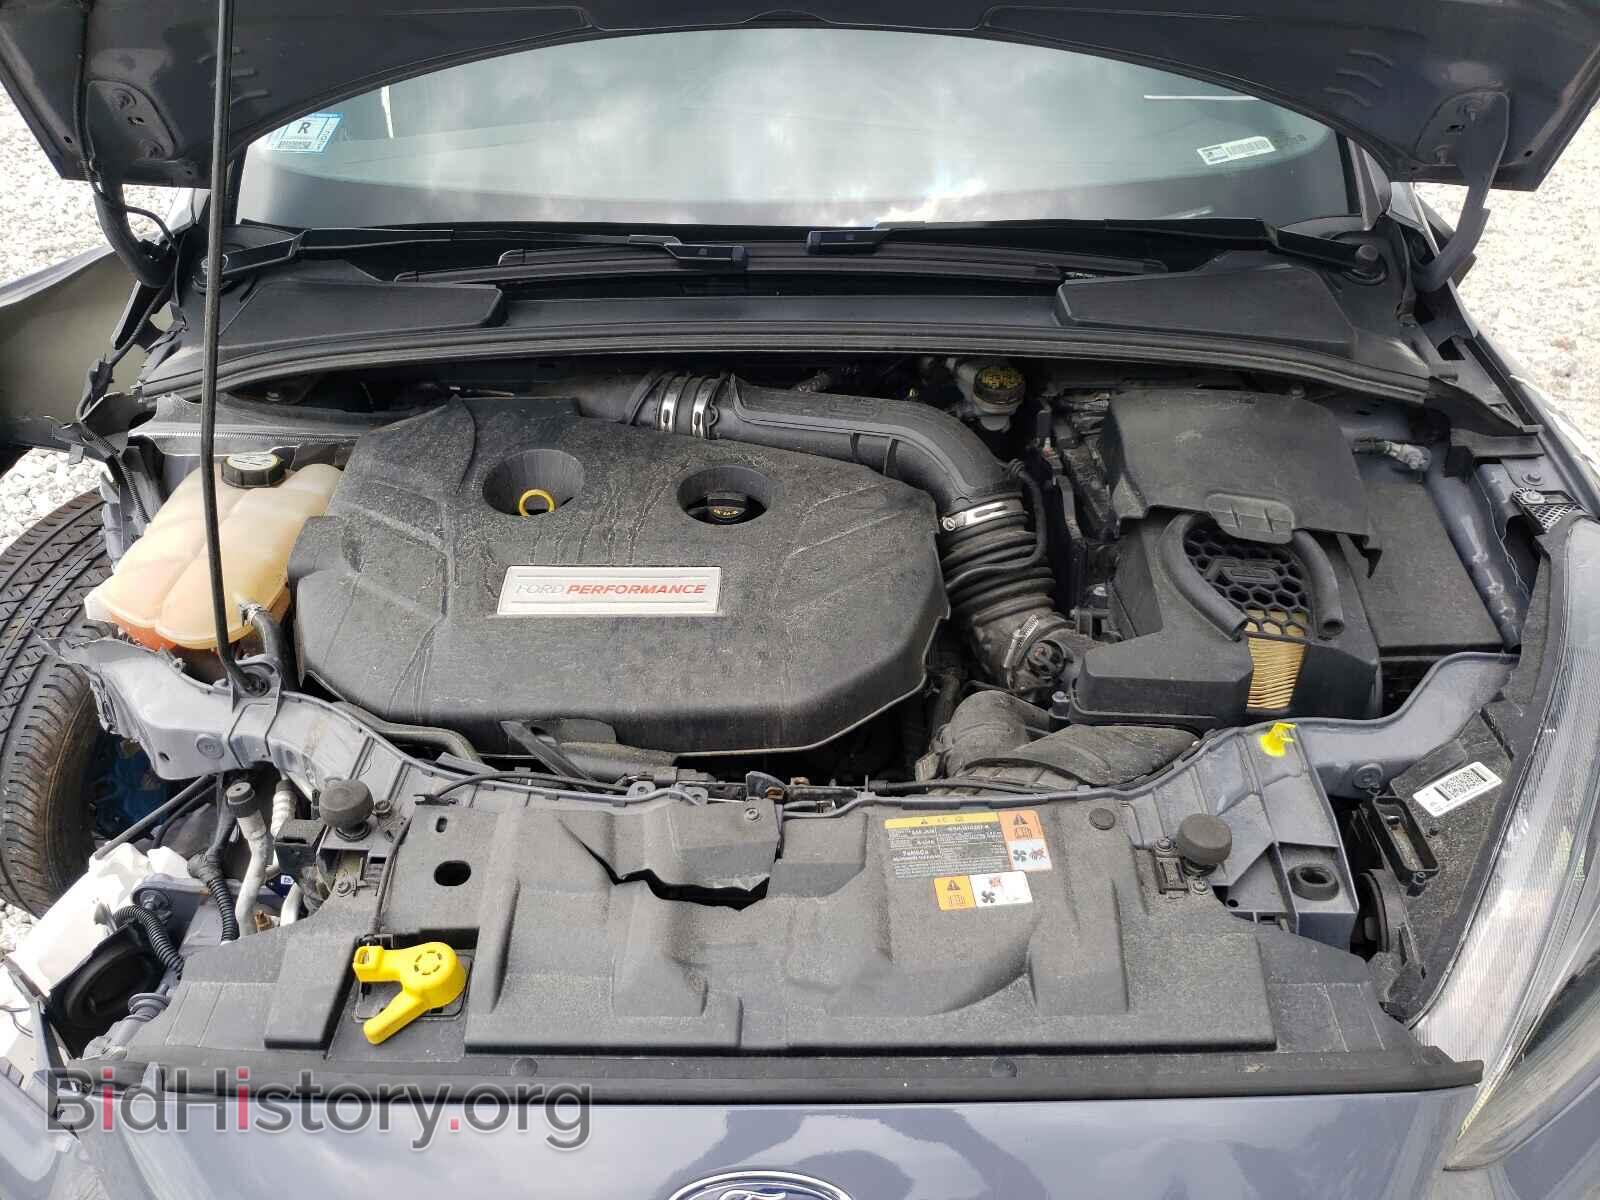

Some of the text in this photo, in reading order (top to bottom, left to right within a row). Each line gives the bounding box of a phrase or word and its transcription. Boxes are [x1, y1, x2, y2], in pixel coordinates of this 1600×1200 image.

[297, 121, 311, 134] R
[515, 583, 706, 595] FORD PERFORMANCE
